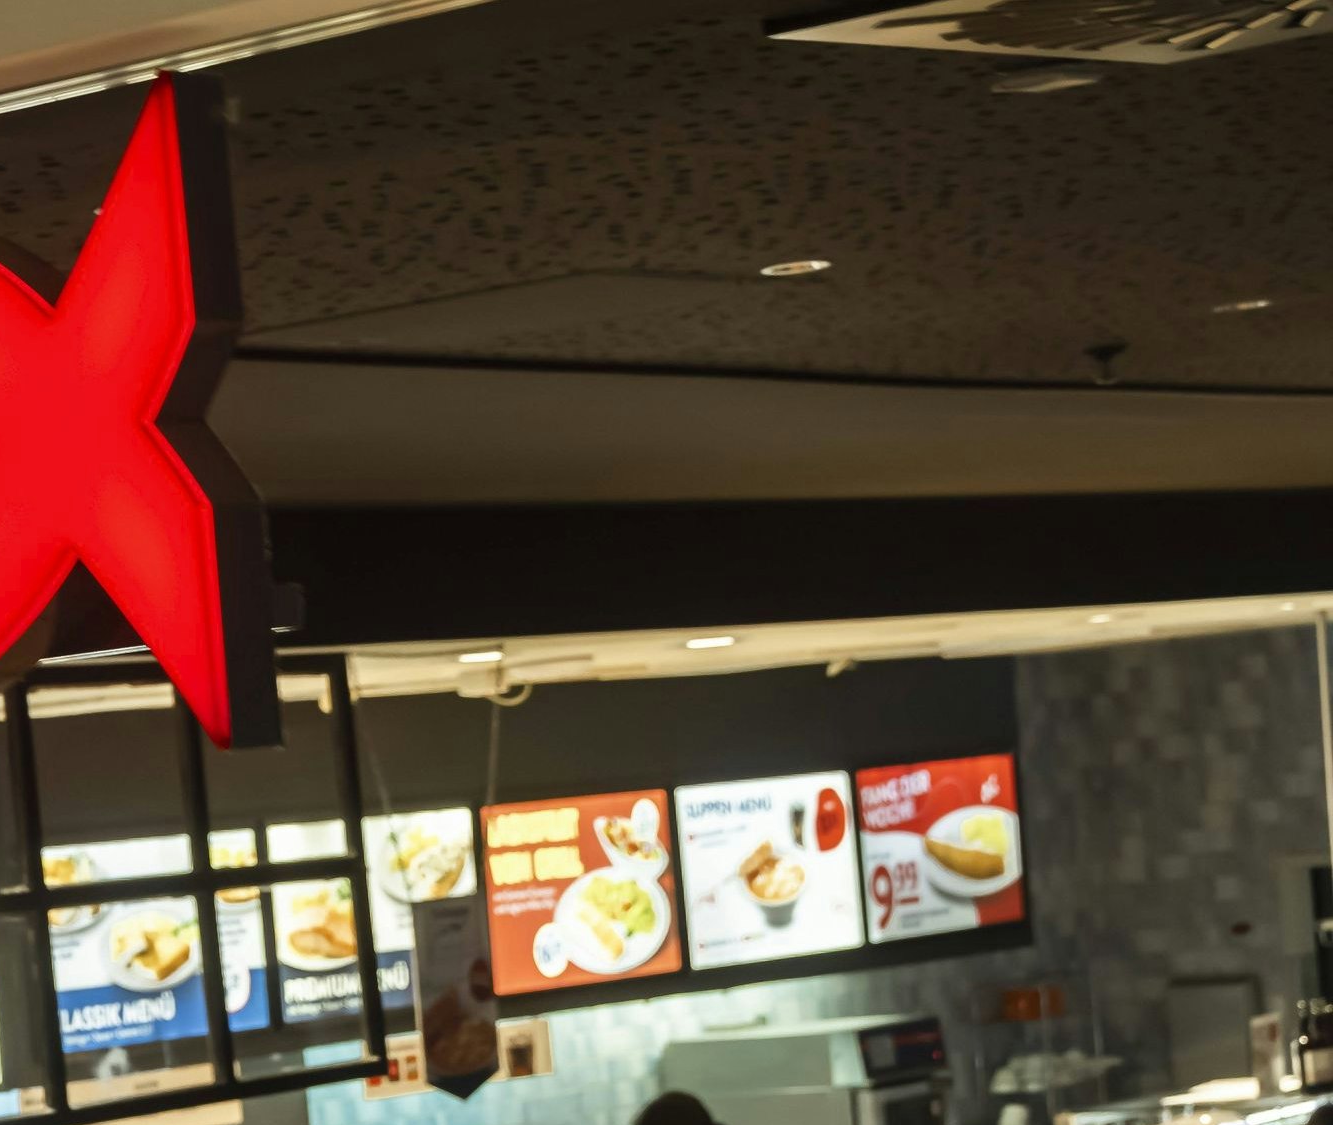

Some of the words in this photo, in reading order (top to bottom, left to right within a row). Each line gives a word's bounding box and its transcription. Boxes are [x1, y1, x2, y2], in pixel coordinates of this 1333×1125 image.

[872, 864, 893, 930] 9
[59, 1002, 122, 1034] LASSIK
[123, 990, 176, 1024] MENÜ
